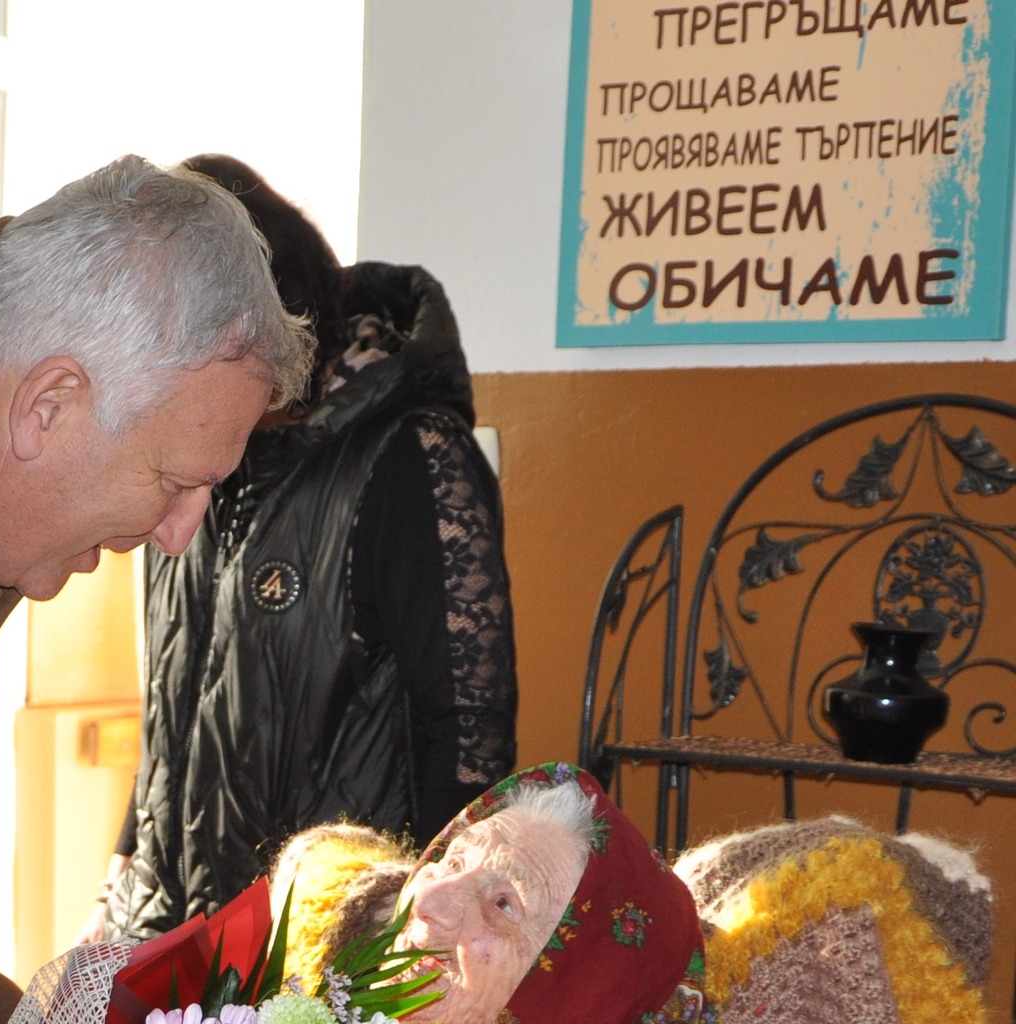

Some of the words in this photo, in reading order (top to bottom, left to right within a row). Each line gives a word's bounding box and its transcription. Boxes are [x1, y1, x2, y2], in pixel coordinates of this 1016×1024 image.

[653, 0, 970, 49] ПРЕГРЪЩАМЕ
[600, 66, 842, 116] ПРОЩАВАМЕ
[597, 127, 783, 173] ПРОЯВЯВАМЕ
[796, 115, 960, 161] ТЪРПЕНИЕ
[600, 183, 827, 238] ЖИВЕЕМ
[608, 249, 960, 312] ОБИЧАМЕ
